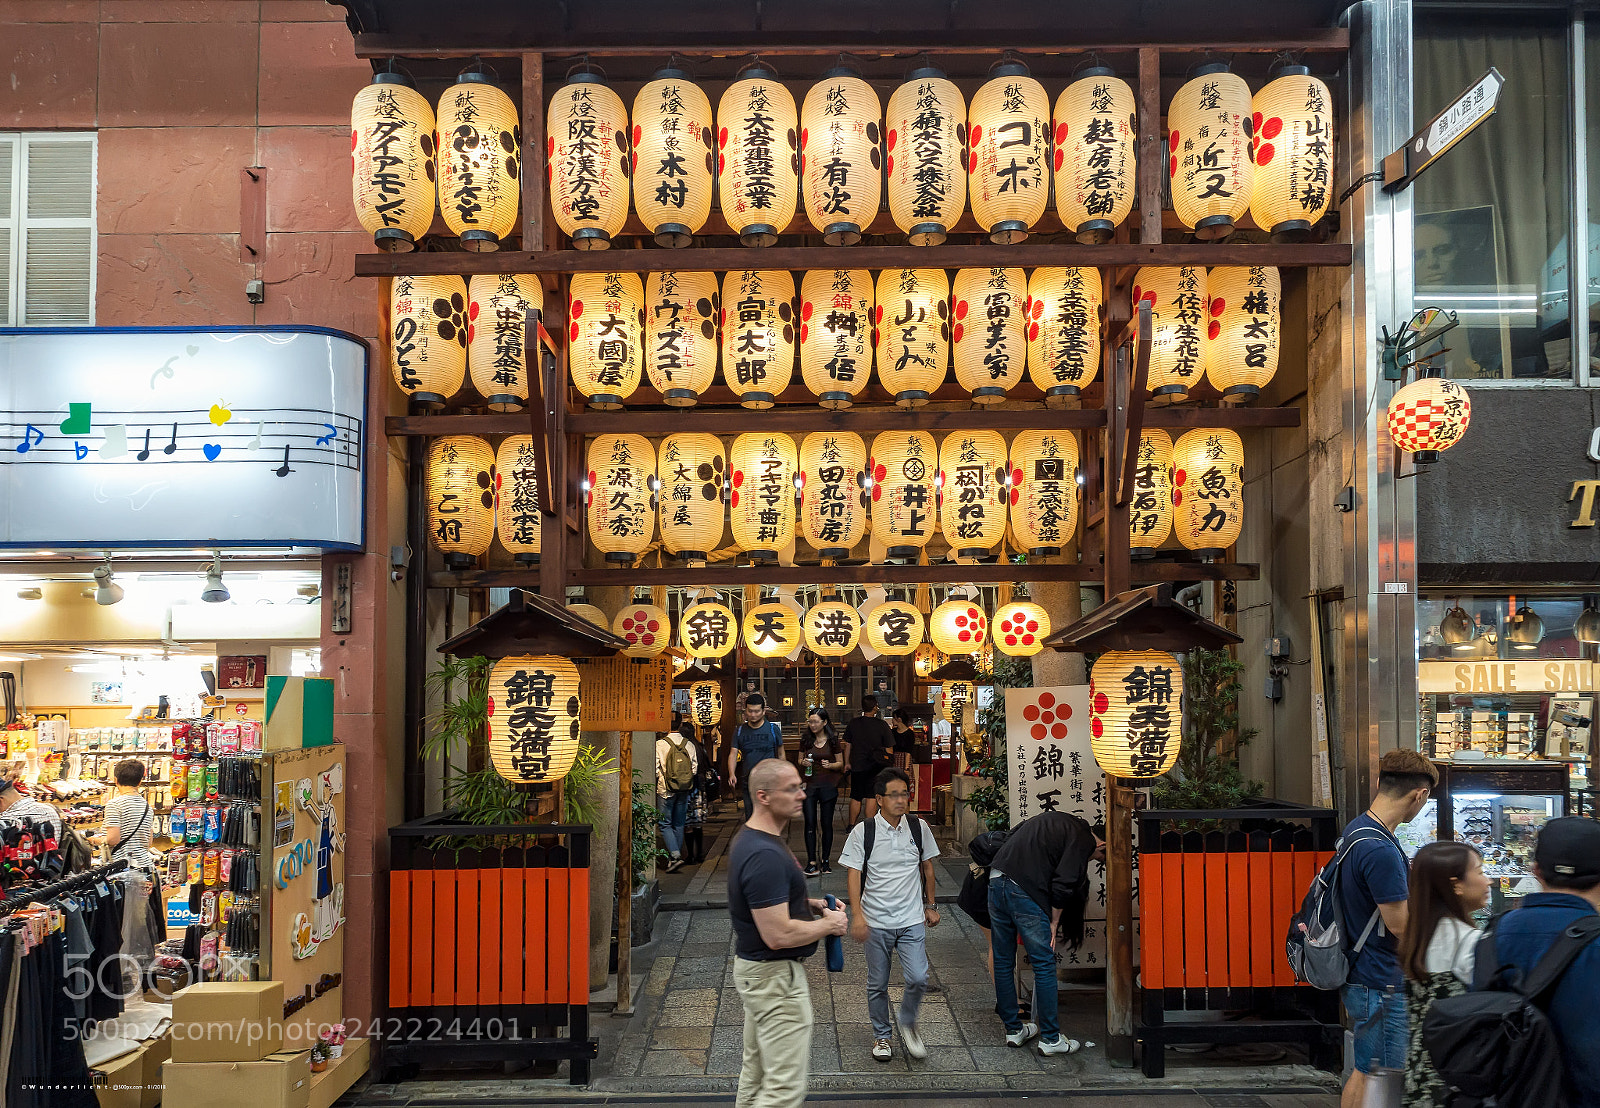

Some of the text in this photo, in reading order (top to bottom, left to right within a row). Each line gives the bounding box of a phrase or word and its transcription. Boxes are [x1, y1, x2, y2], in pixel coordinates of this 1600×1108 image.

[375, 89, 404, 119] 献燈
[454, 91, 479, 123] 献燈
[567, 88, 598, 118] 献燈
[660, 86, 687, 116] 献燈
[747, 85, 773, 112] 献燈
[824, 85, 850, 116] 献燈
[915, 83, 942, 111] 献燈
[1002, 83, 1029, 112] 献燈
[1090, 84, 1116, 113] 献燈
[1199, 82, 1223, 110] 献燈
[1305, 83, 1325, 113] 献燈
[660, 117, 682, 151] 鮮魚
[687, 120, 701, 142] 錦
[1216, 111, 1231, 139] 懐石
[371, 120, 408, 226] ダイアモンド
[567, 119, 599, 220] 阪本漢方堂
[743, 112, 777, 209] 大岩建設工業
[911, 111, 946, 218] 積水ハウス株式会社
[1194, 142, 1234, 199] 近又
[1299, 114, 1330, 213] 山本清掃
[655, 152, 689, 209] 木村
[821, 157, 852, 215] 有次
[395, 275, 415, 297] 燈
[498, 273, 521, 298] 献燈
[603, 272, 627, 299] 献燈
[658, 271, 680, 297] 献燈
[740, 270, 763, 295] 献燈
[831, 269, 853, 293] 献燈
[899, 268, 919, 294] 献燈
[988, 267, 1009, 290] 献燈
[1062, 267, 1085, 291] 献燈
[1176, 267, 1199, 292] 献燈
[1248, 267, 1267, 289] 献燈
[396, 299, 412, 315] 錦
[489, 294, 530, 311] 京都
[605, 299, 621, 315] 錦
[831, 293, 853, 311] 錦
[736, 296, 767, 385] 寅太郎
[894, 299, 925, 372] 山とみ
[1055, 290, 1088, 382] 幸福堂老舗
[1170, 293, 1202, 377] 佐竹生花店
[1241, 289, 1270, 368] 権太呂
[395, 317, 422, 390] のとよ
[491, 307, 526, 387] 中央信用金庫
[597, 314, 628, 388] 大國屋
[1433, 380, 1464, 440] 新京極
[441, 442, 458, 464] 献燈
[611, 439, 632, 465] 献燈
[762, 438, 780, 459] 献燈
[820, 437, 841, 463] 献燈
[907, 435, 924, 457] 献燈
[959, 438, 981, 463] 献燈
[1041, 435, 1060, 458] 献燈
[1205, 435, 1226, 460] 献燈
[606, 468, 633, 538] 源久秀
[672, 463, 697, 526] 大綿屋
[757, 460, 783, 542] アキヤマ歯科
[818, 465, 847, 543] 田丸印房
[1197, 465, 1231, 531] 魚力
[437, 494, 463, 543] 乙羽
[901, 484, 928, 536] 井上
[958, 486, 985, 539] かね松
[1037, 481, 1063, 542] 五感食楽
[686, 608, 916, 650] 錦 天 満 宮
[659, 658, 667, 691] 錦天満宮
[1455, 664, 1517, 692] SALE
[503, 669, 557, 781] 錦天満宮
[1121, 665, 1174, 777] 錦天満宮
